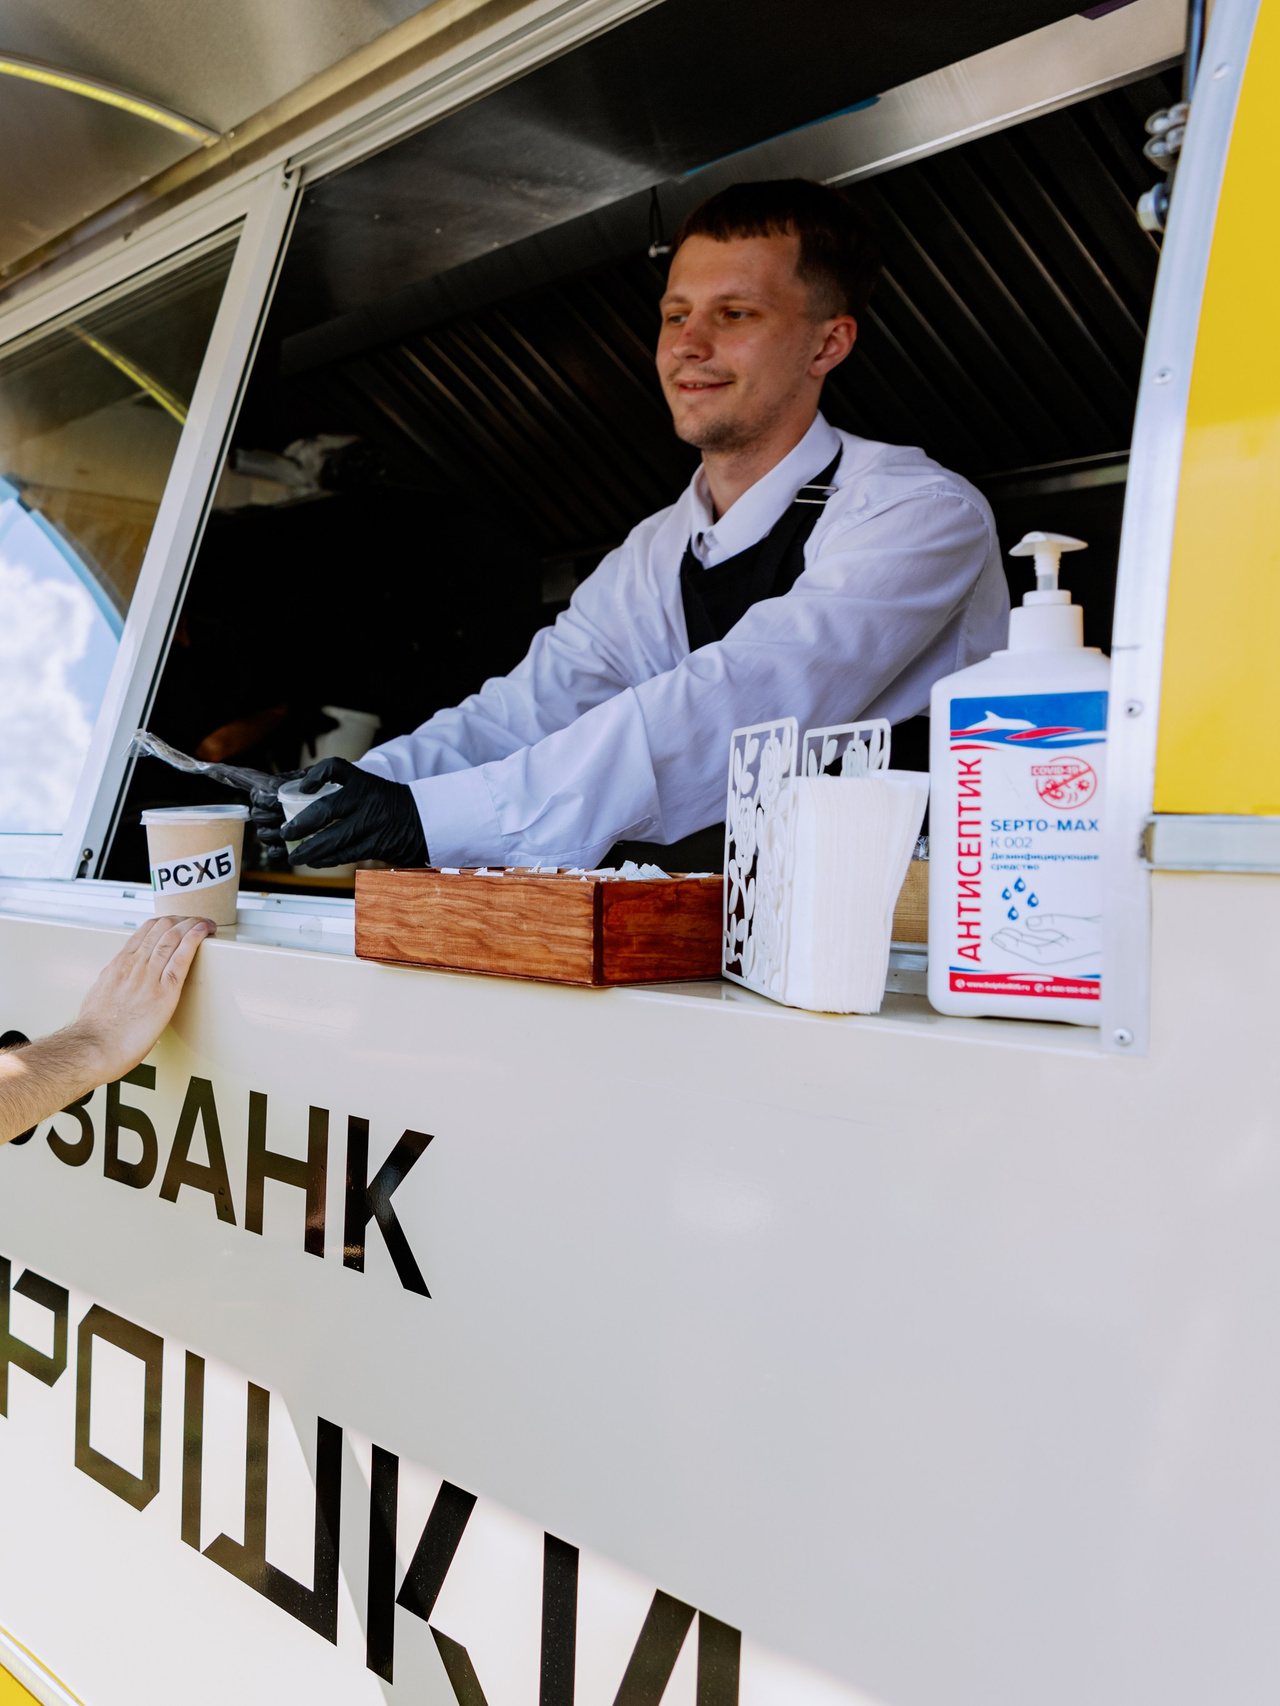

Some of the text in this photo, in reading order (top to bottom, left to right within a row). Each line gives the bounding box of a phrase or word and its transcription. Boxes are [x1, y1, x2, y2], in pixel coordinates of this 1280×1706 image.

[990, 819, 1099, 832] SEPTO-MAX
[1004, 836, 1033, 849] 002
[158, 852, 232, 890] РСХБ
[957, 758, 982, 963] АНТИСЕПТИК
